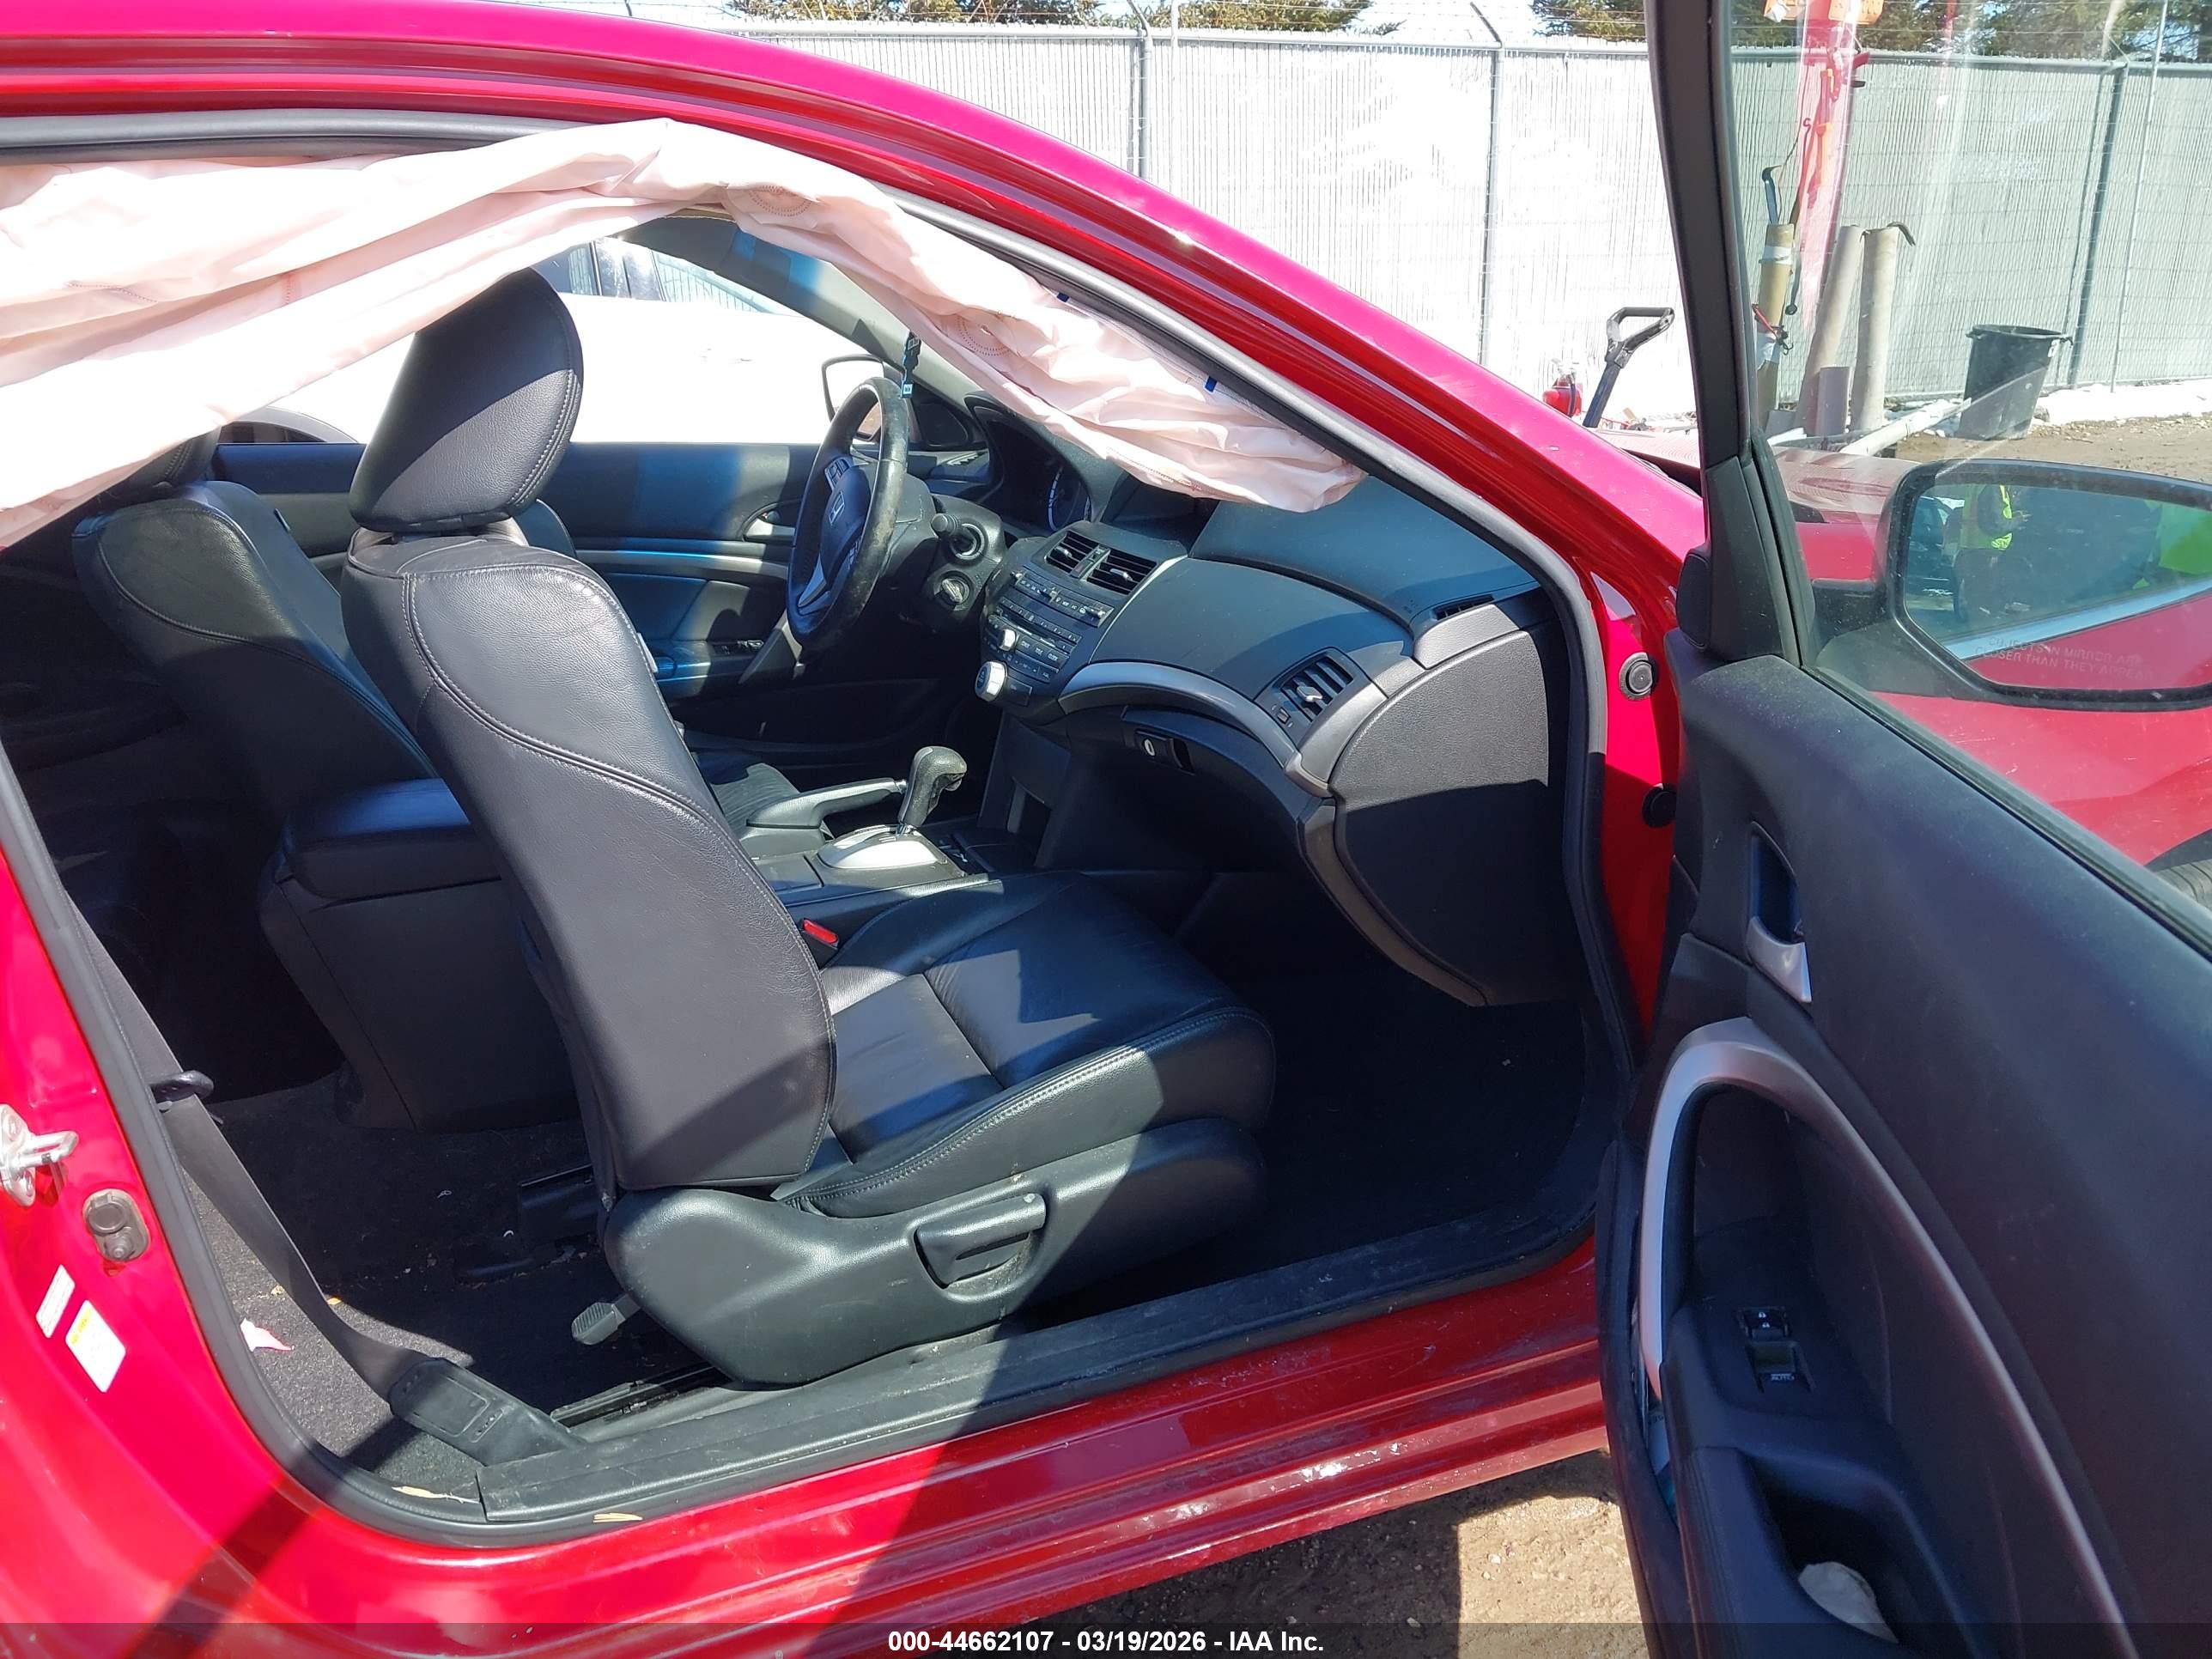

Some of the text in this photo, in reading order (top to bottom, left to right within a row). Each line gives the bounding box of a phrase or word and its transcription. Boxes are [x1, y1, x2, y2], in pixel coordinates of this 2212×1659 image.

[2063, 647, 2111, 662] MIRROR
[2026, 653, 2058, 667] THAN
[2063, 659, 2096, 672] THEY
[2099, 665, 2153, 681] APPEAR
